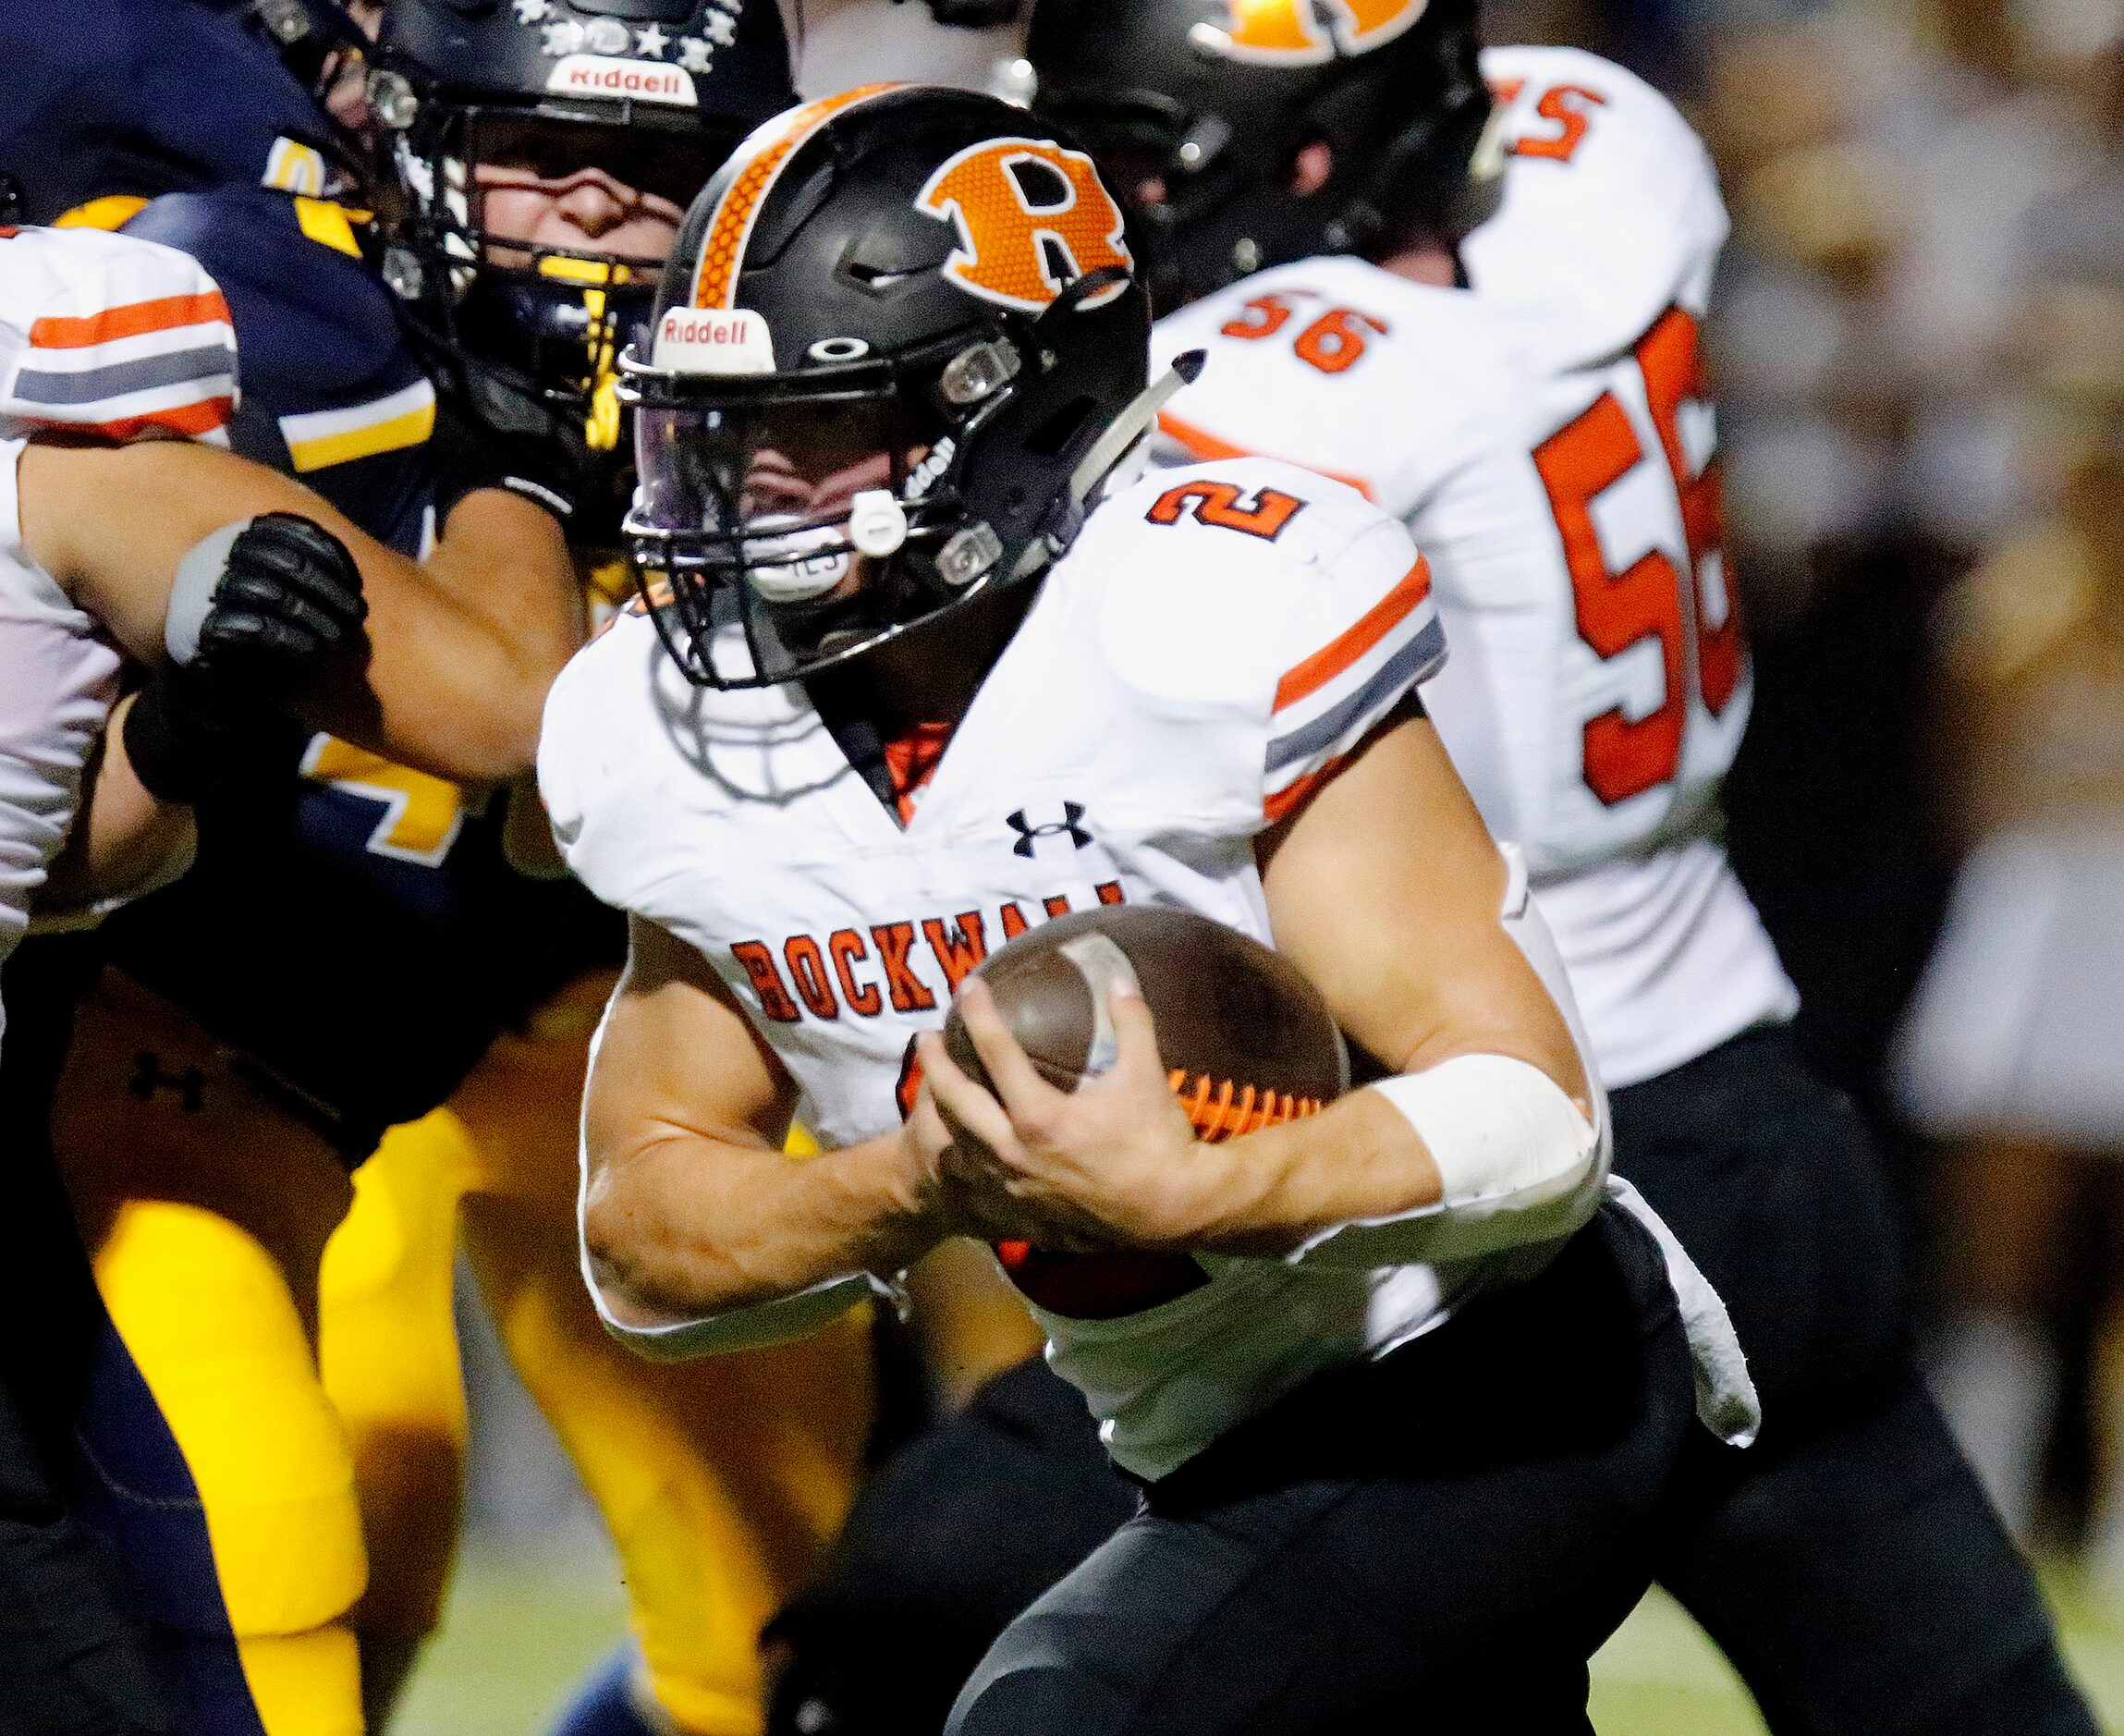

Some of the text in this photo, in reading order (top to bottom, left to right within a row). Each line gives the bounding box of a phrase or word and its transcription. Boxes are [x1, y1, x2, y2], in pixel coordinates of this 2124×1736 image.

[914, 137, 1135, 312] R
[665, 319, 747, 344] Riddell
[1220, 290, 1389, 373] 56
[903, 435, 956, 499] ddell
[1144, 480, 1311, 544] 2
[1531, 305, 1739, 807] 56
[729, 879, 1126, 1022] ROCKW
